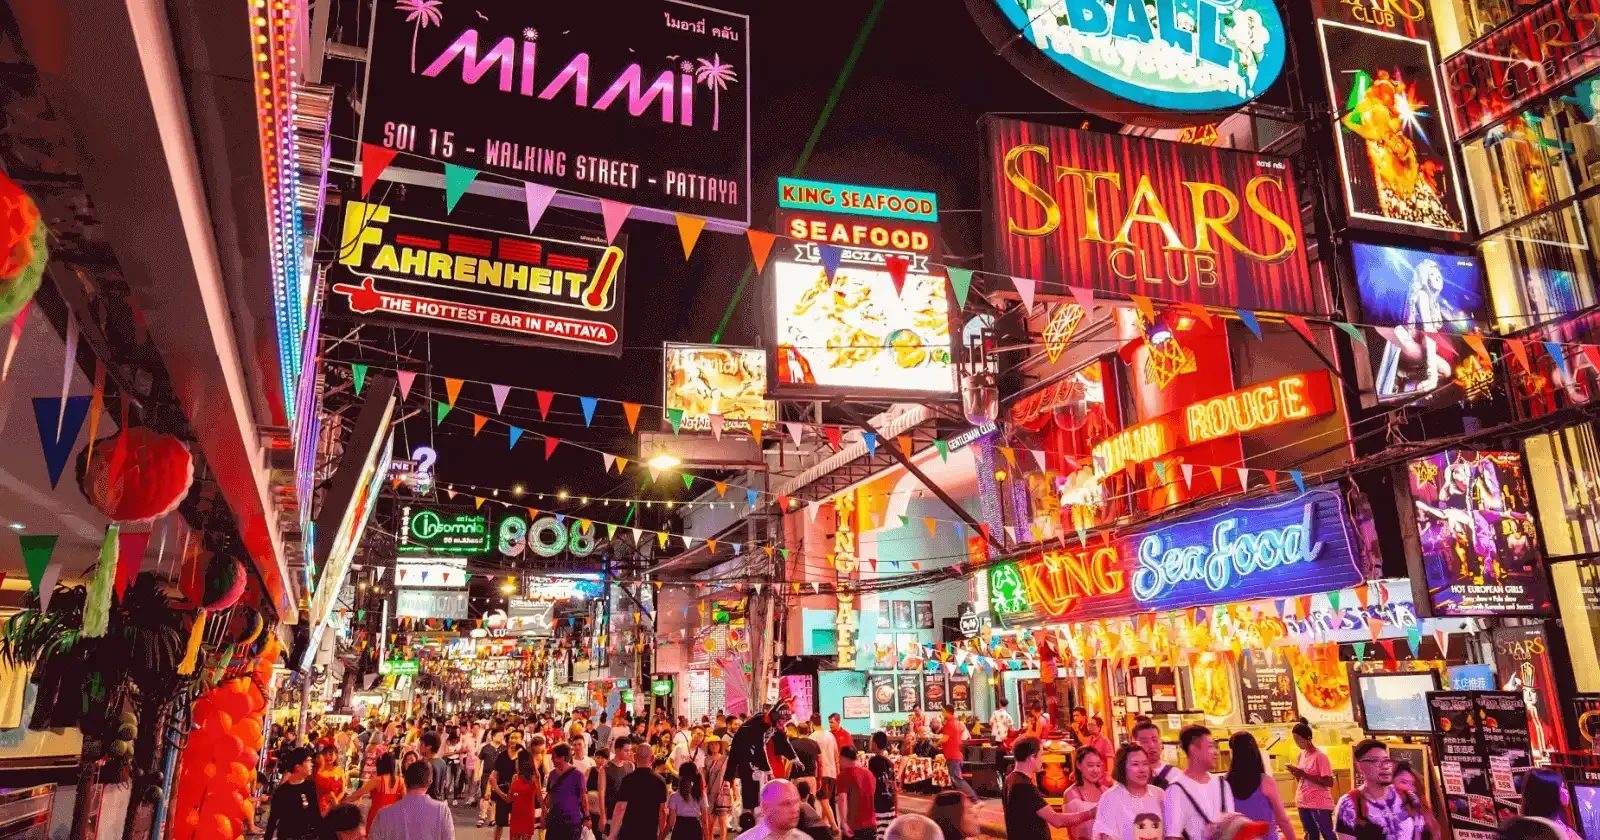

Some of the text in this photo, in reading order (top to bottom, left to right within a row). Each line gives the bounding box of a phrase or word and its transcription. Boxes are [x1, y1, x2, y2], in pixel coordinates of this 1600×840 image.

[664, 12, 739, 41] ไมอามี่ คลับ
[1352, 6, 1396, 28] CLUB
[383, 121, 416, 153] SOI
[430, 128, 455, 158] 15
[486, 138, 567, 178] WALKING
[576, 154, 640, 190] STREET
[666, 170, 738, 206] PATTAYA
[783, 185, 934, 215] KING SEAFOOD
[1003, 144, 1298, 263] STARS
[340, 200, 588, 299] FAHRENHEIT
[790, 218, 930, 251] SEAFOOD
[1109, 248, 1219, 288] CLUB
[380, 295, 608, 340] THE HOTTEST BAR IN PATTAYA
[1187, 378, 1309, 442] ROUGE
[948, 422, 996, 449] GENTLEMAN CLUB
[1021, 548, 1124, 616] KING
[1451, 585, 1466, 593] HOT
[1467, 585, 1504, 594] EUROPEAN
[1496, 637, 1545, 655] STARS
